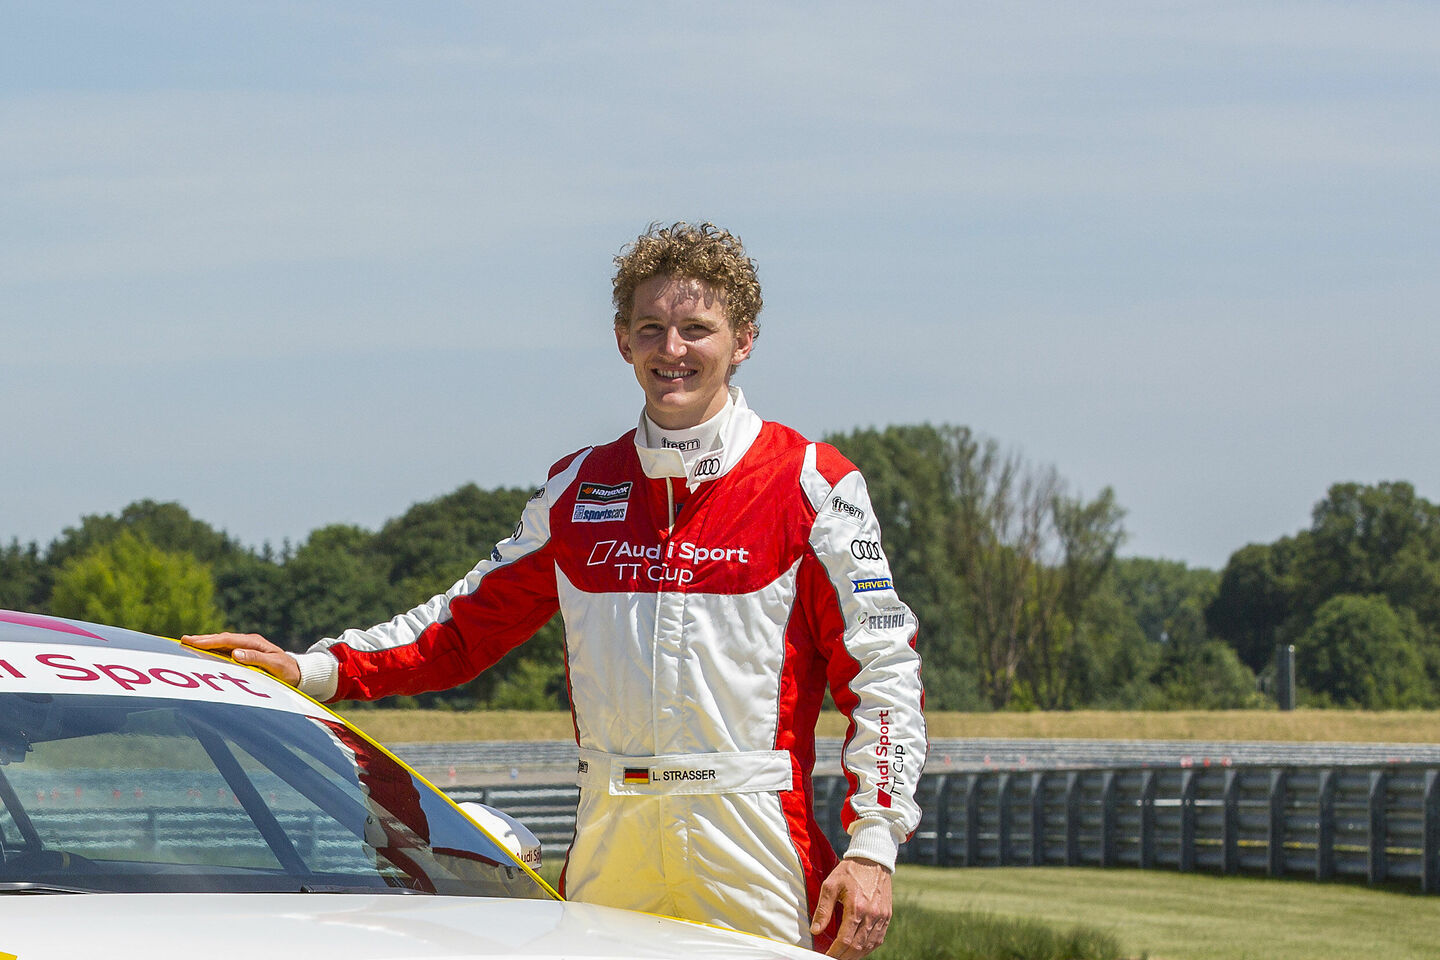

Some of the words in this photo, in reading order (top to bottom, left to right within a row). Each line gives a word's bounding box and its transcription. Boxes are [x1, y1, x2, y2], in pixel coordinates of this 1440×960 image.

[833, 497, 864, 520] freem
[615, 541, 674, 560] Audi
[678, 542, 749, 565] Sport
[614, 563, 642, 580] TT
[647, 563, 694, 586] Cup
[857, 580, 893, 591] RAVEN
[868, 614, 905, 629] REHAU
[35, 653, 272, 699] Sport
[875, 710, 891, 757] Sport
[893, 744, 906, 773] Cup
[652, 771, 661, 781] L.
[663, 770, 716, 781] STRASSER
[890, 776, 904, 795] TT
